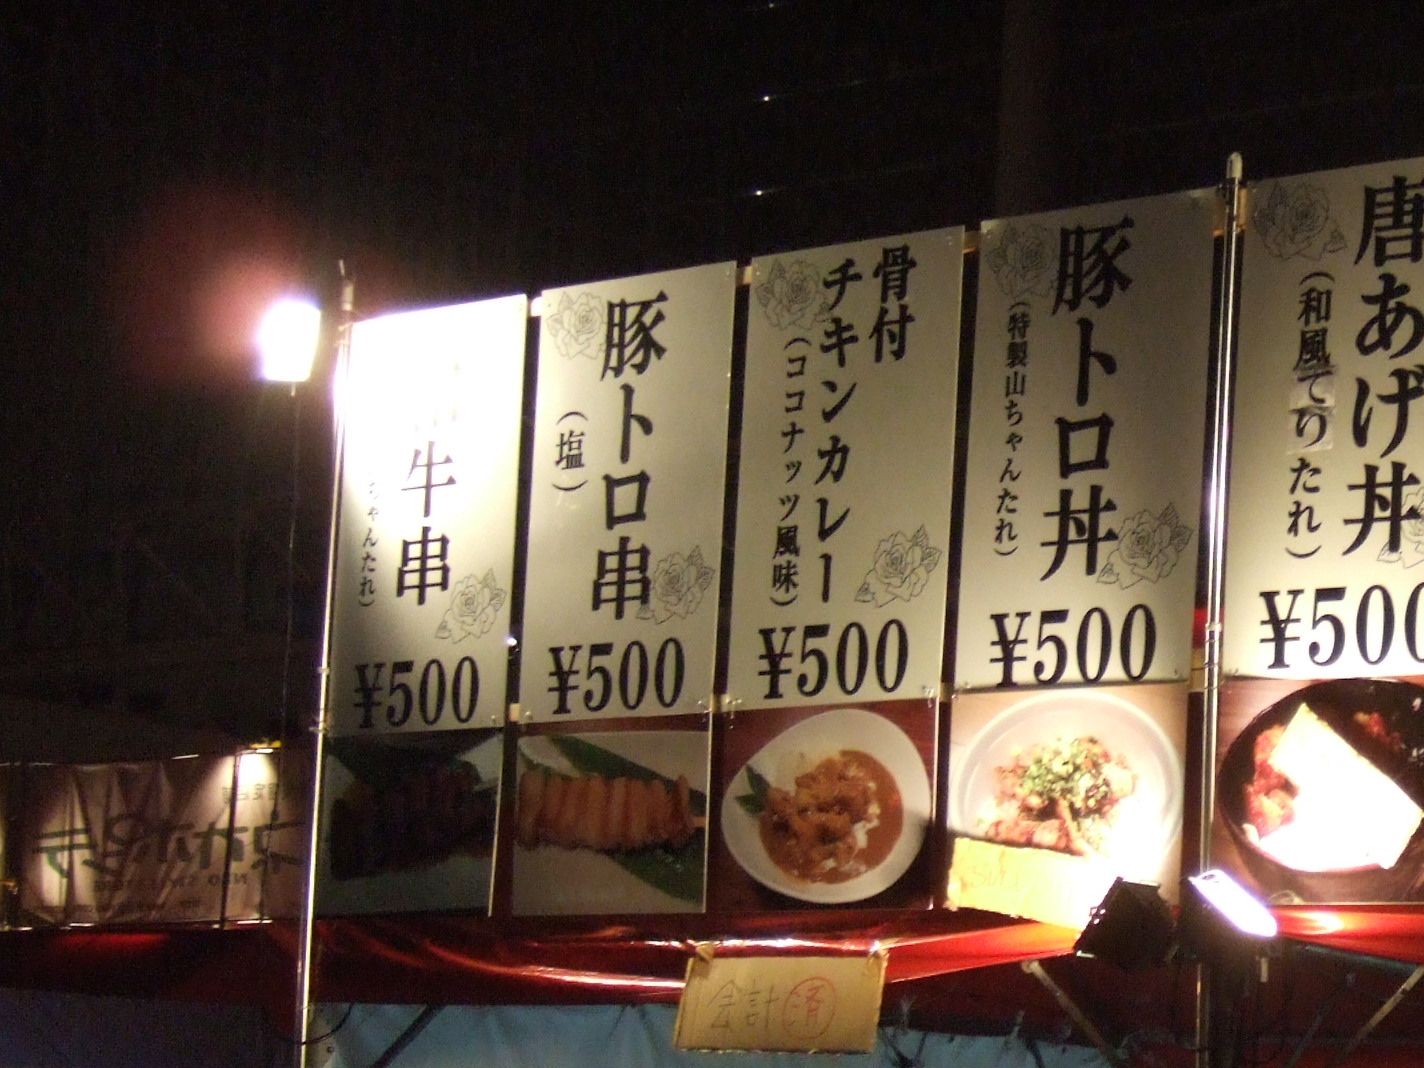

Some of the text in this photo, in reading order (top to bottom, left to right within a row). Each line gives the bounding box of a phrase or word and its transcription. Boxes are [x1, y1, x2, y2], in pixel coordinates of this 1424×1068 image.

[868, 244, 918, 364] 骨付
[815, 256, 863, 604] チキンカレー
[1039, 218, 1134, 582] 豚トロ丼
[590, 289, 670, 622] 豚トロ串
[353, 654, 480, 730] ¥500
[547, 636, 686, 716] ¥500
[757, 617, 910, 701] ¥500
[989, 603, 1157, 690] ¥500
